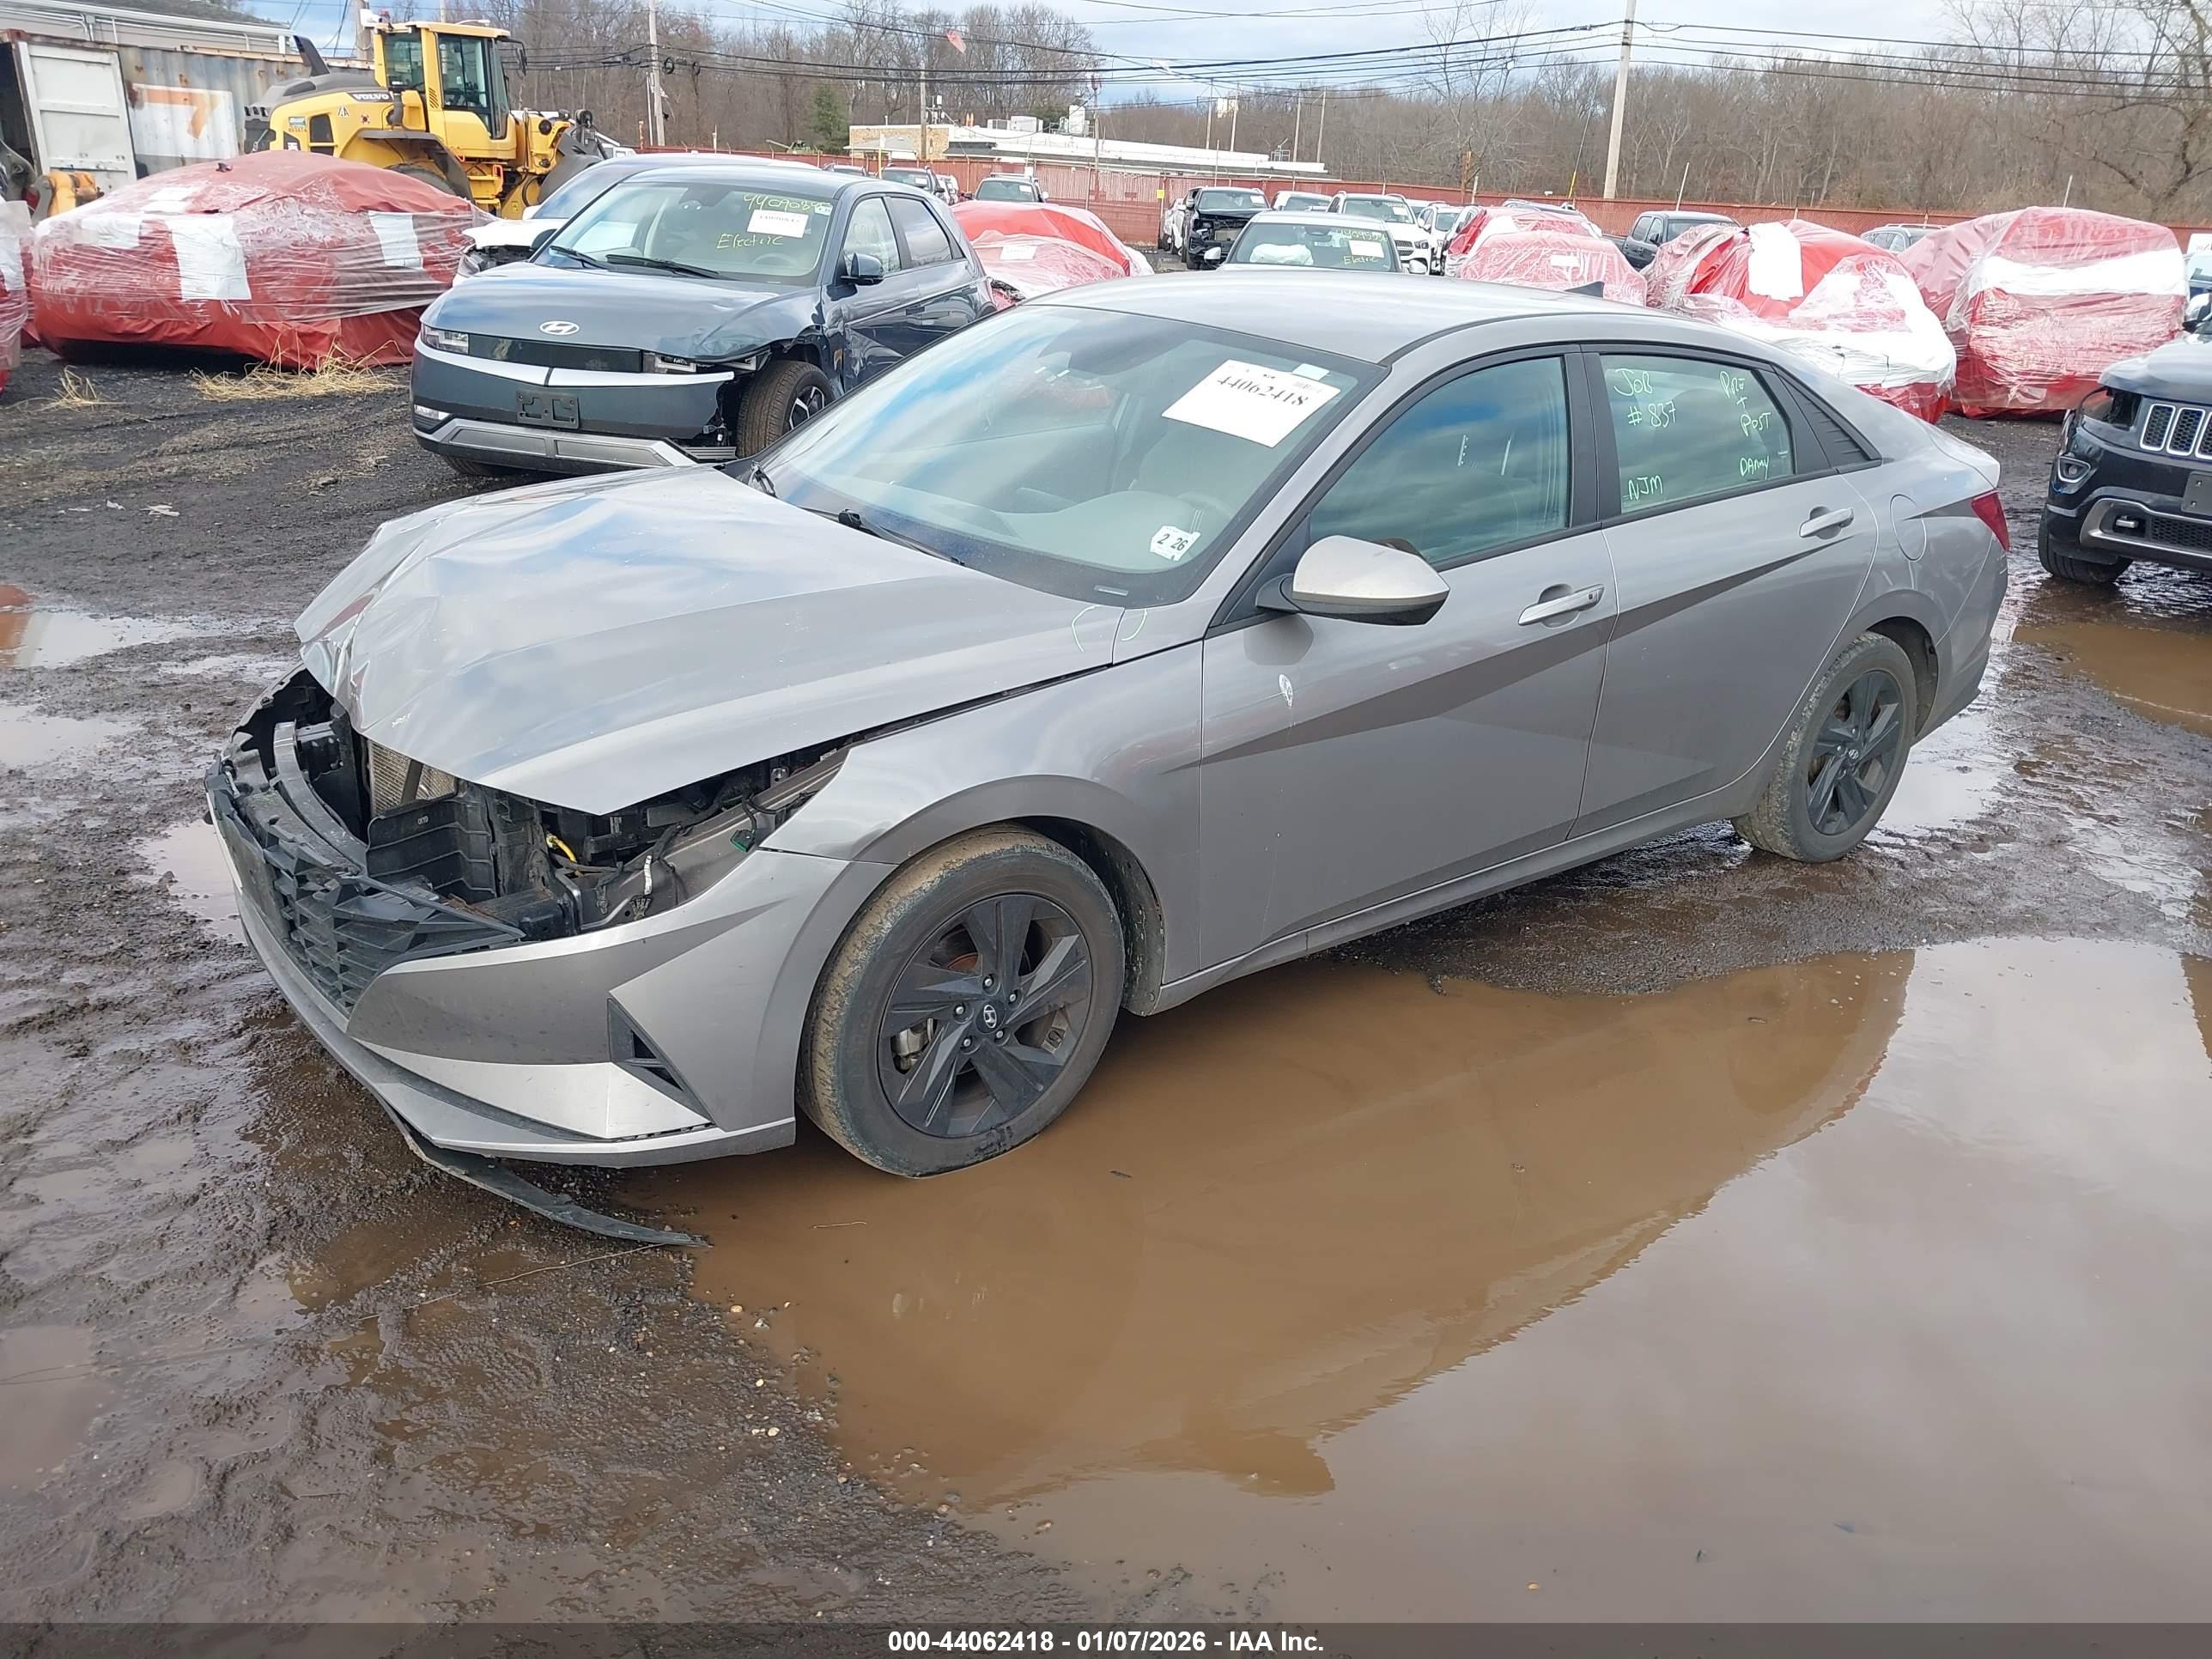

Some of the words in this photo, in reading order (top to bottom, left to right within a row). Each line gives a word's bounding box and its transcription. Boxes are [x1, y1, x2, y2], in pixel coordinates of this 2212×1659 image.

[1217, 375, 1309, 405] 44062418
[1613, 368, 1653, 396] JOB
[1628, 475, 1662, 501] NJM
[1157, 532, 1170, 545] 2
[1170, 537, 1189, 551] 26
